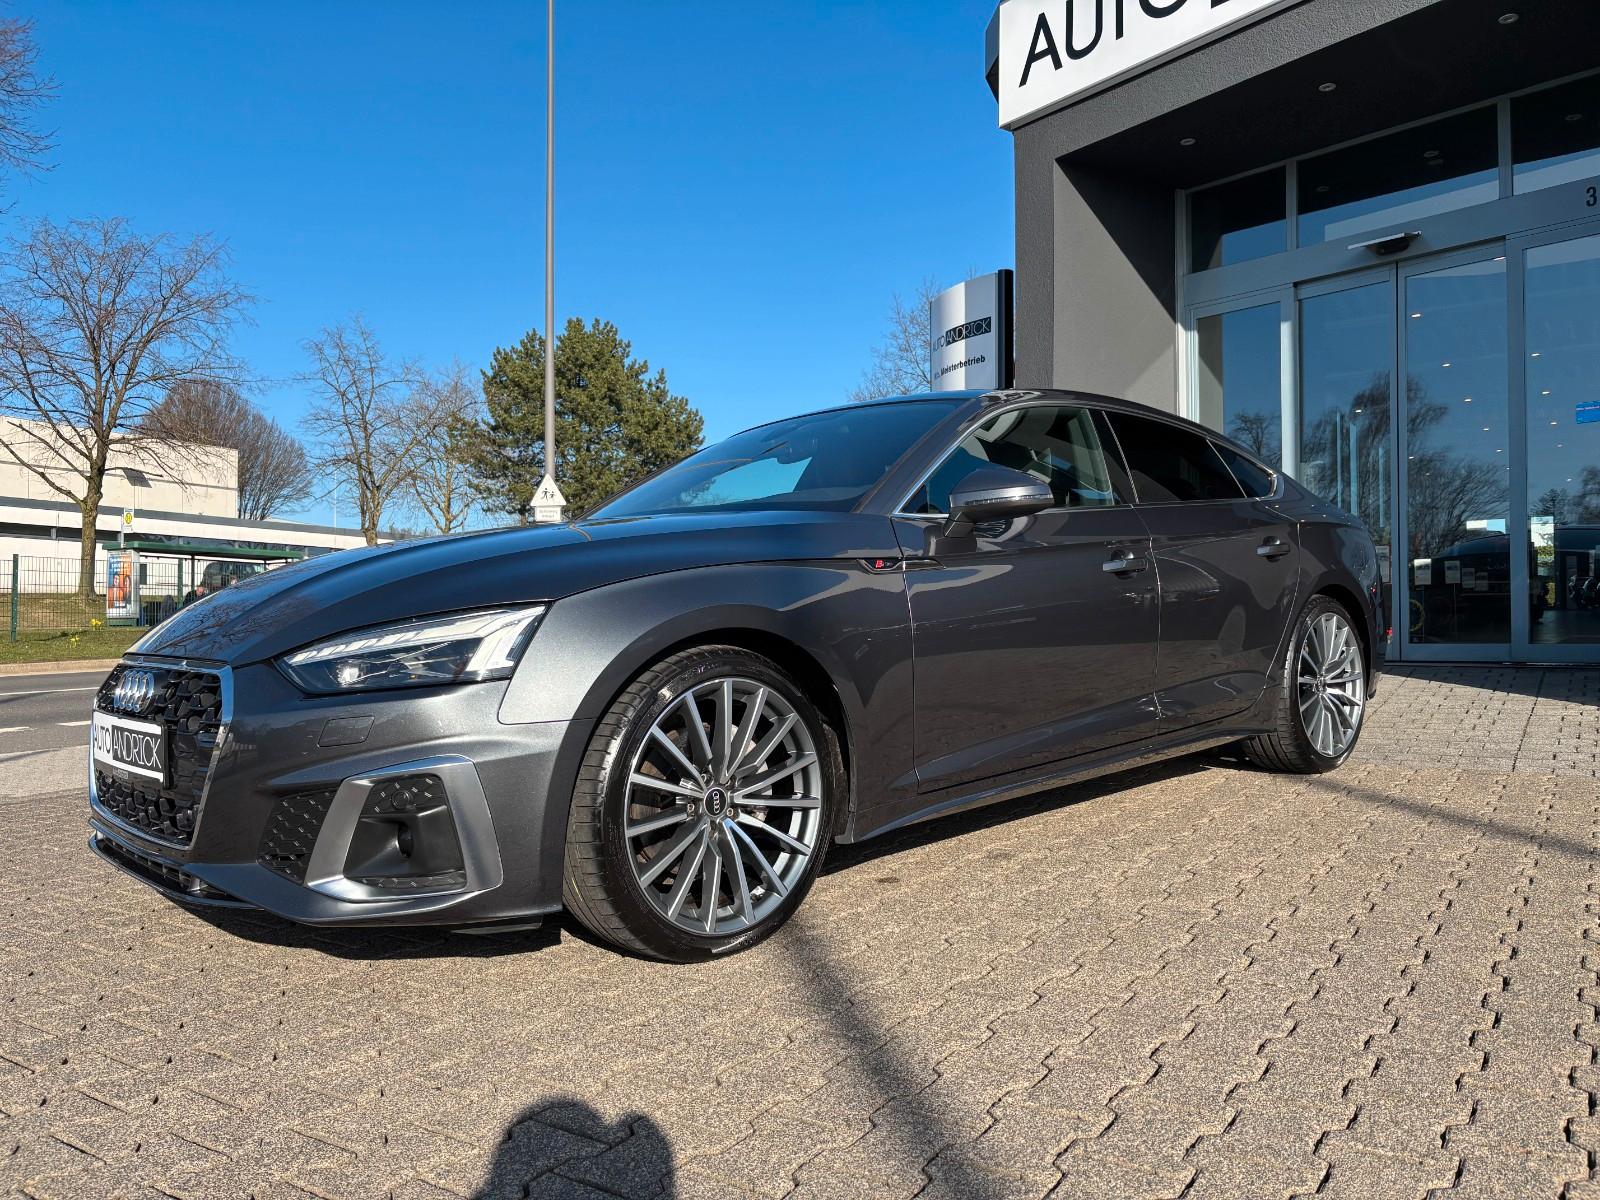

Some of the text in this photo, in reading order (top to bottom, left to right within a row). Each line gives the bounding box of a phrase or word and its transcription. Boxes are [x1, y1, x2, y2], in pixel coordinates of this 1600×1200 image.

[1018, 0, 1188, 88] AU
[1586, 186, 1598, 207] 3
[946, 319, 990, 343] ANDRICK
[94, 723, 162, 769] AUTO ANDRICK
